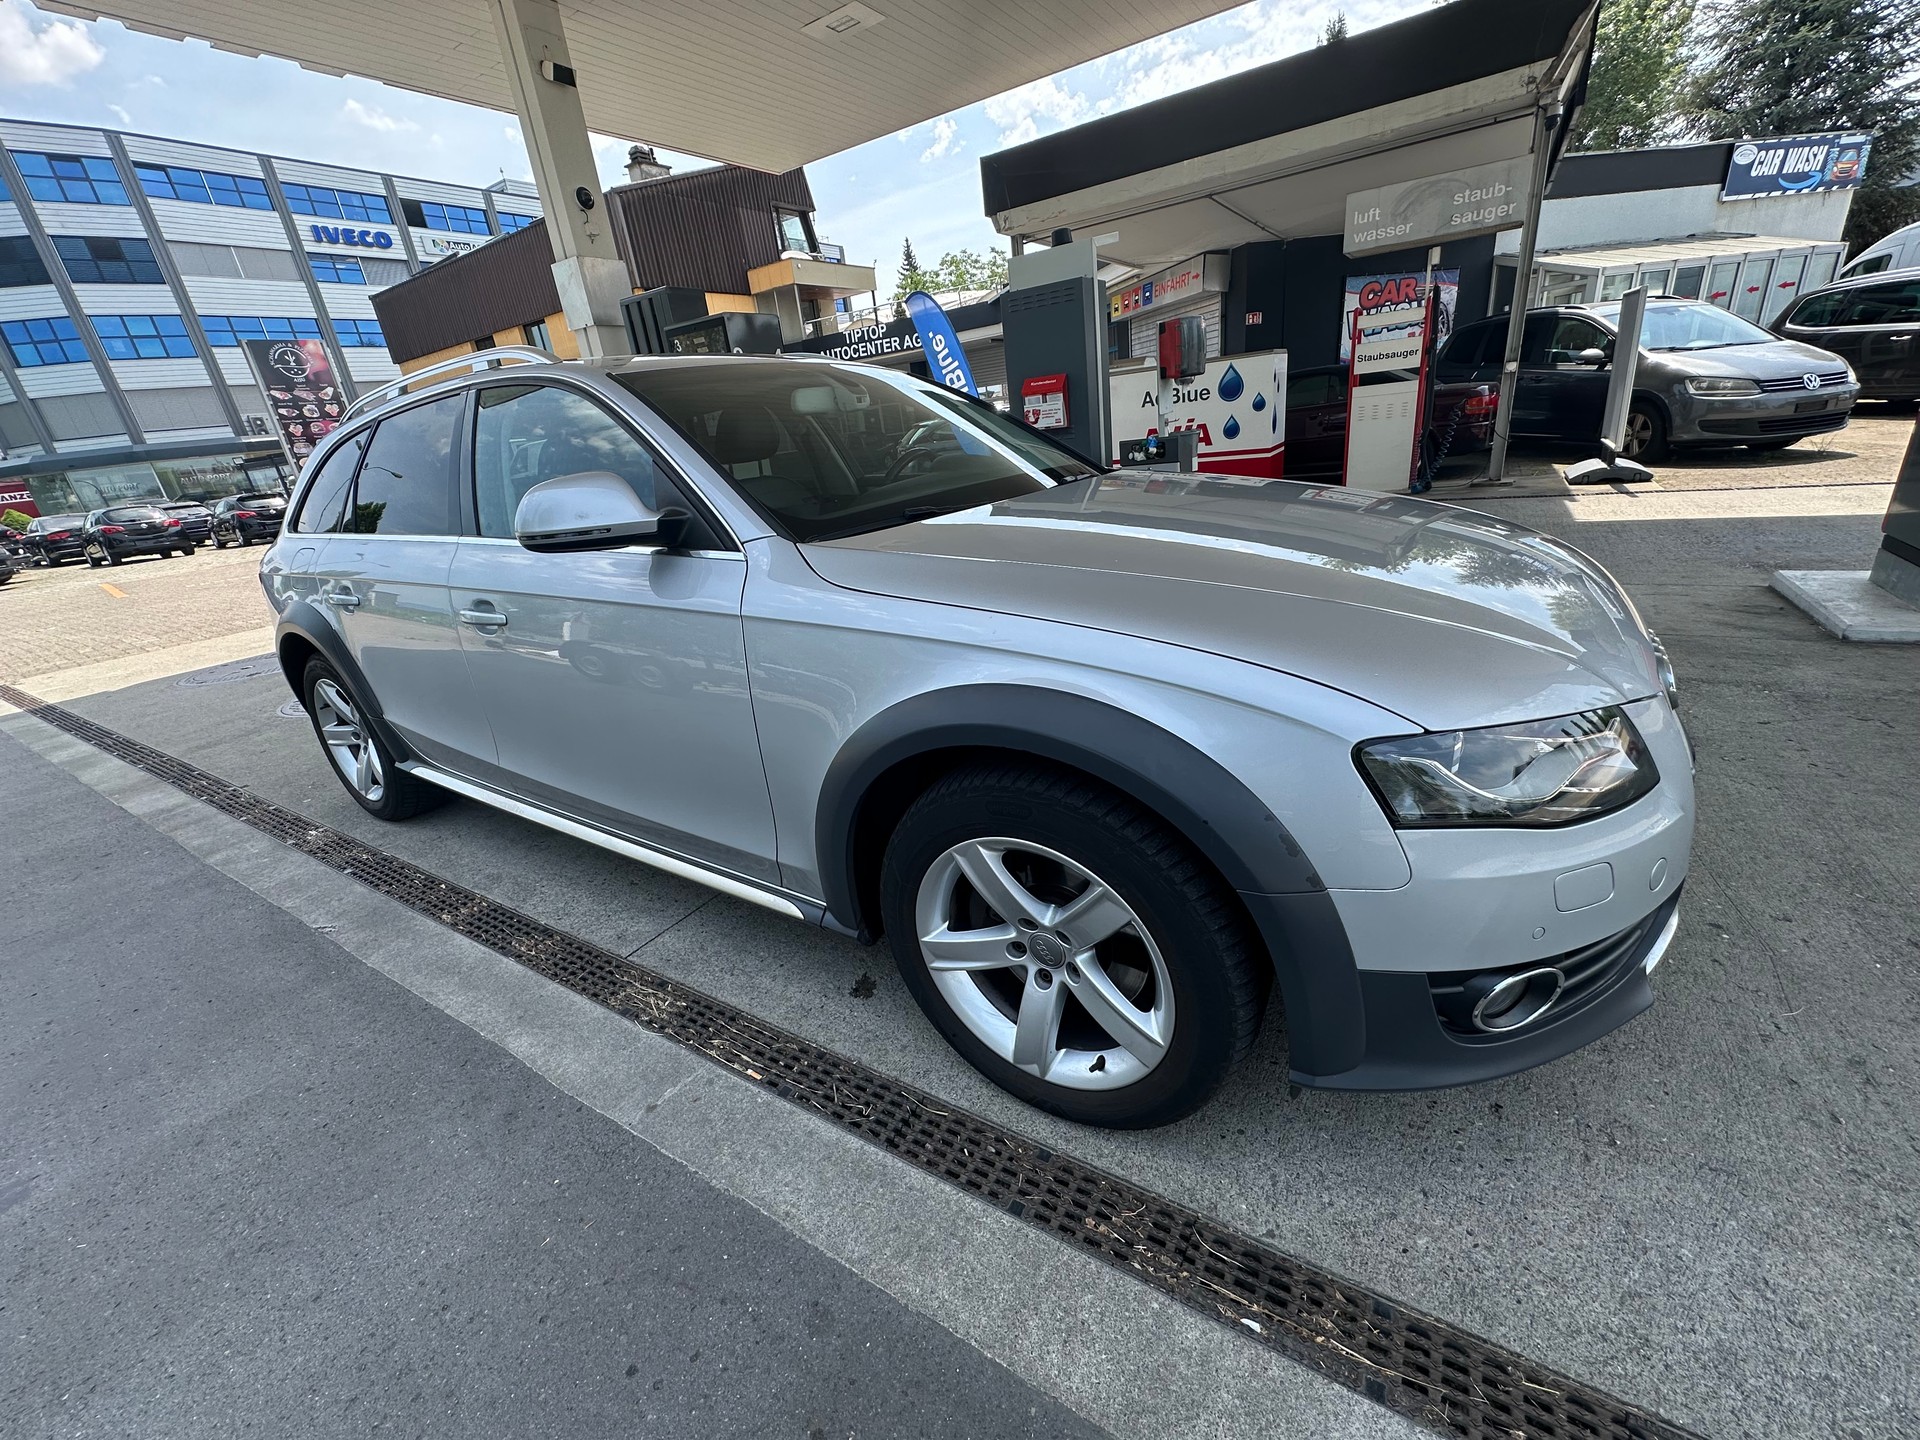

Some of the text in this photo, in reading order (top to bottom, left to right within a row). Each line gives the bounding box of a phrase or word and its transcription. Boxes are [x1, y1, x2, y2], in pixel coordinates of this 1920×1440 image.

[1751, 148, 1785, 177] CAR
[1782, 145, 1829, 174] WASH
[1453, 182, 1513, 205] staub-
[1354, 207, 1381, 225] luft
[1451, 202, 1517, 226] sauger
[311, 225, 393, 249] IVECO
[1353, 222, 1413, 243] wasser
[1154, 271, 1192, 298] EINFAHRT
[1359, 277, 1417, 308] CAR
[674, 339, 682, 352] 3
[843, 324, 887, 344] TIPTOP
[904, 333, 922, 349] AG
[929, 331, 969, 393] Blue.
[1357, 348, 1419, 363] Staubsauger
